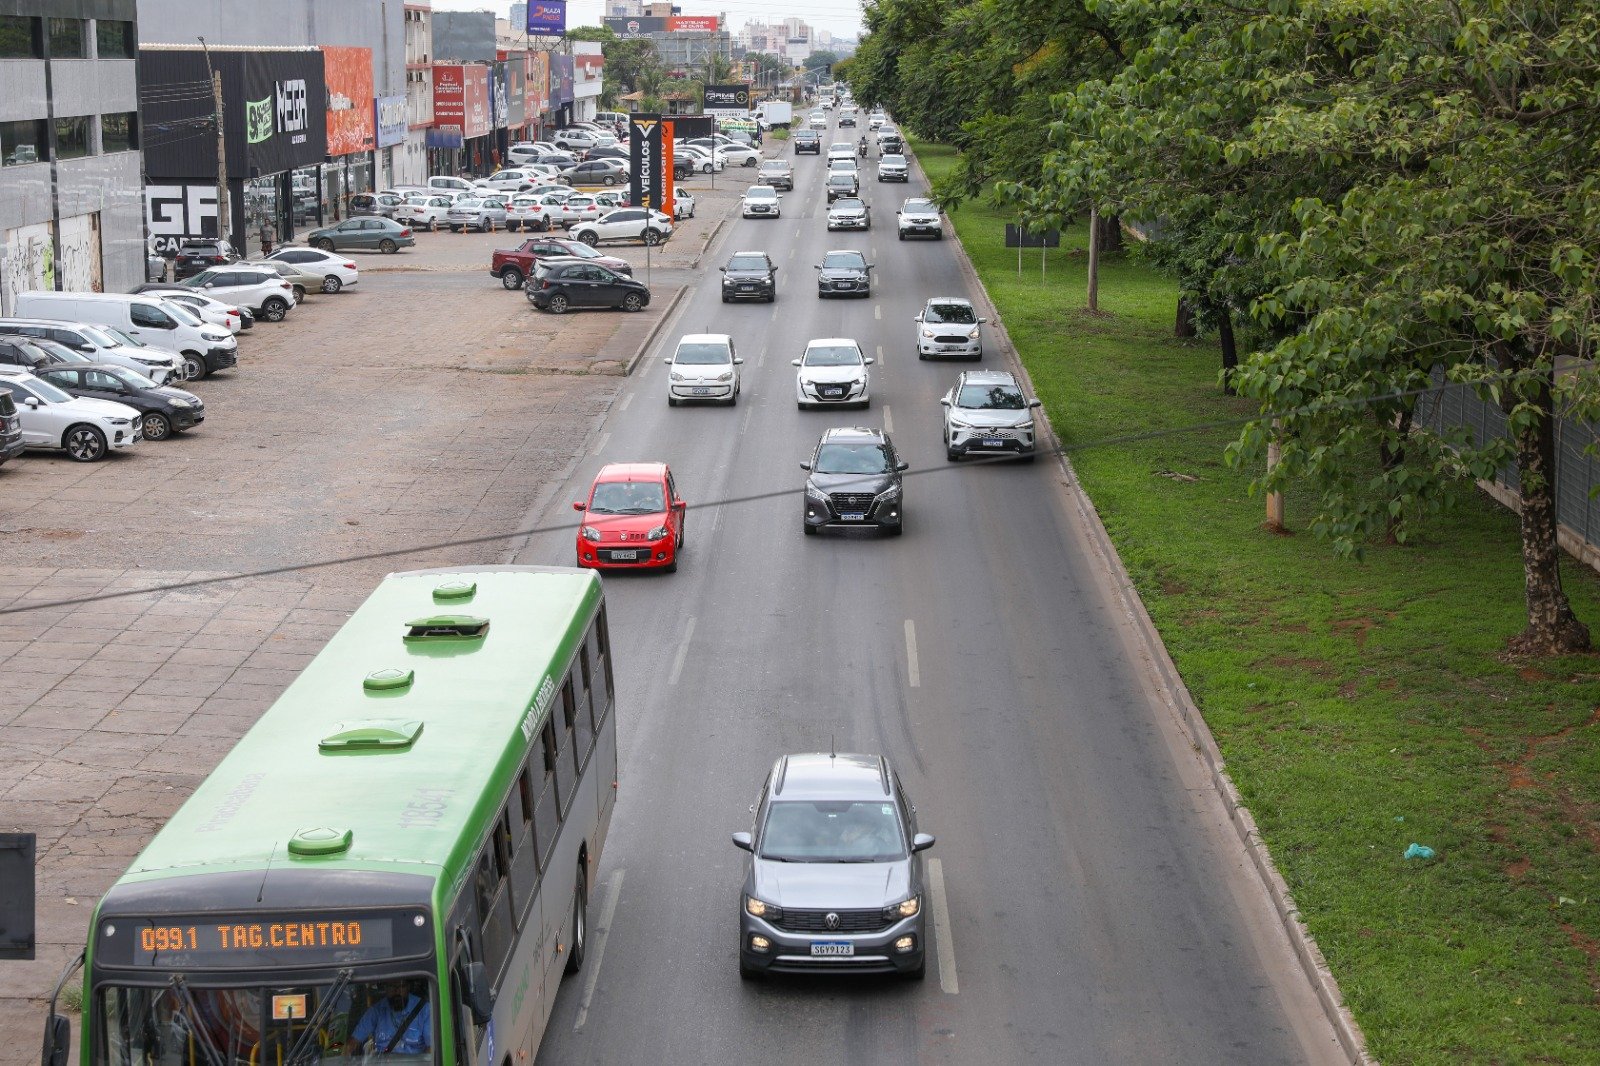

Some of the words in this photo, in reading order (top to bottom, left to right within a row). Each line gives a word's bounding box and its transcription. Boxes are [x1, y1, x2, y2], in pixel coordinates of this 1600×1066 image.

[275, 79, 308, 133] MEGA
[640, 140, 650, 193] VEÍCULOS
[142, 927, 197, 951] 099.1
[218, 922, 361, 948] TAG.CENTRO
